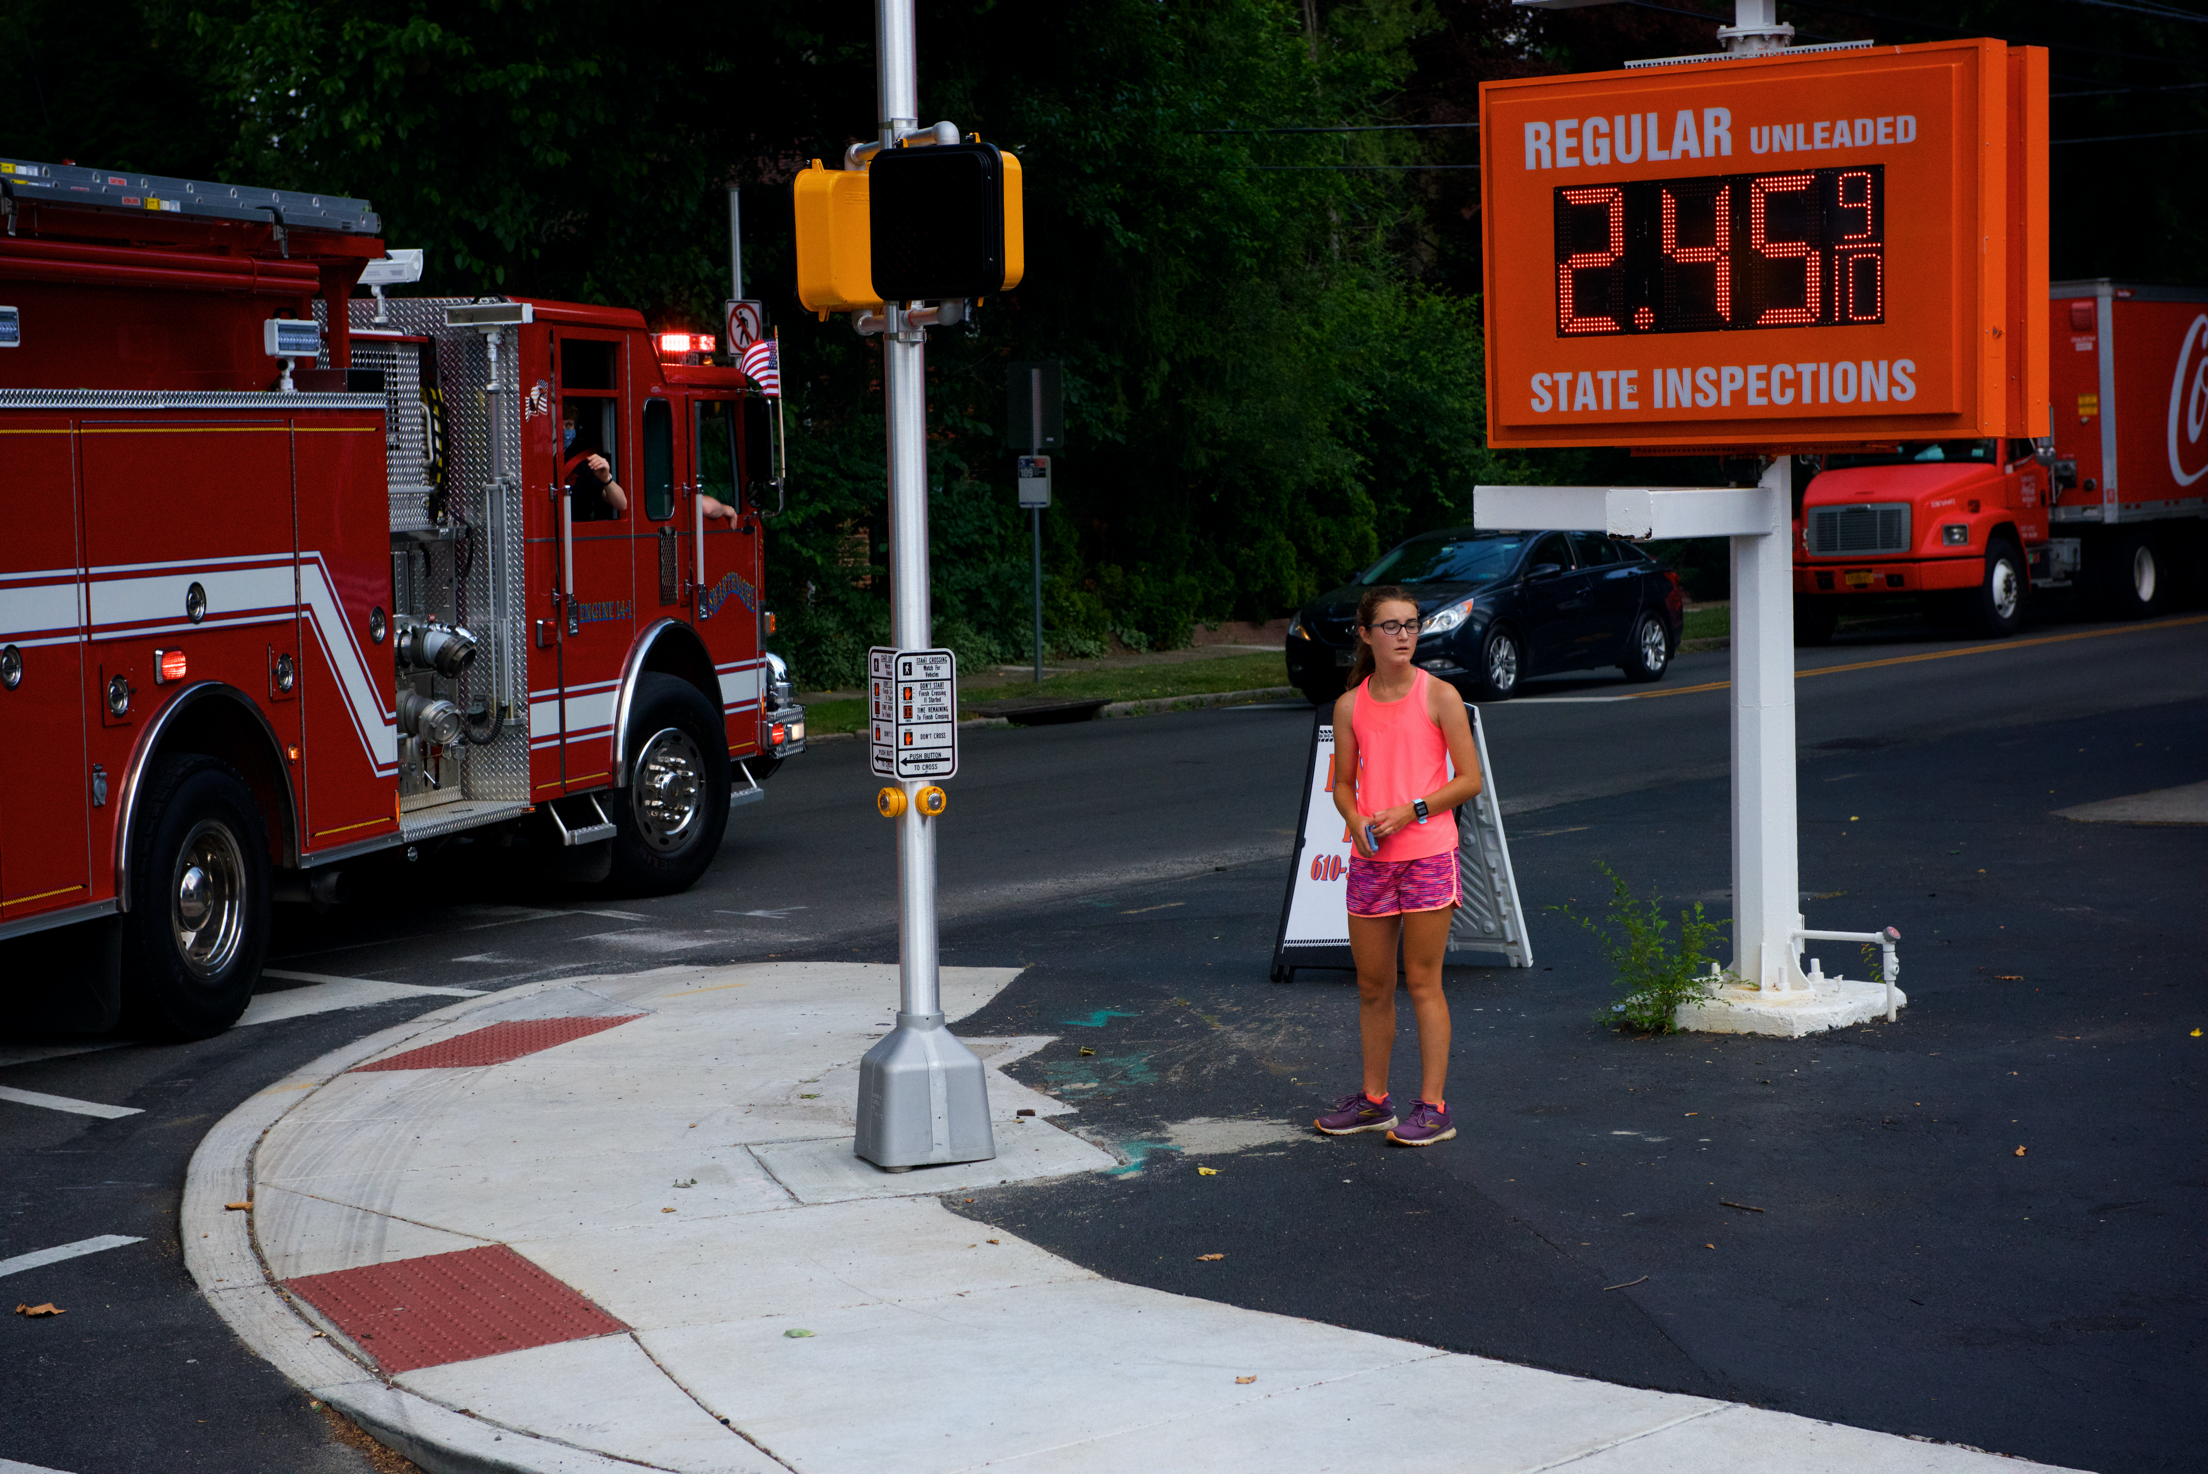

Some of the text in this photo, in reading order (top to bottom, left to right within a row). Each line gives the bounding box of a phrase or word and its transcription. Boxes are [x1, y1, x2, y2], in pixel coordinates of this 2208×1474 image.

[1524, 107, 1917, 170] REGULAR UNLEADED
[1559, 174, 1819, 333] 2.45
[1530, 358, 1917, 413] STATE INSPECTIONS
[1020, 468, 1034, 478] 109
[579, 599, 632, 623] ENGINE 14-1
